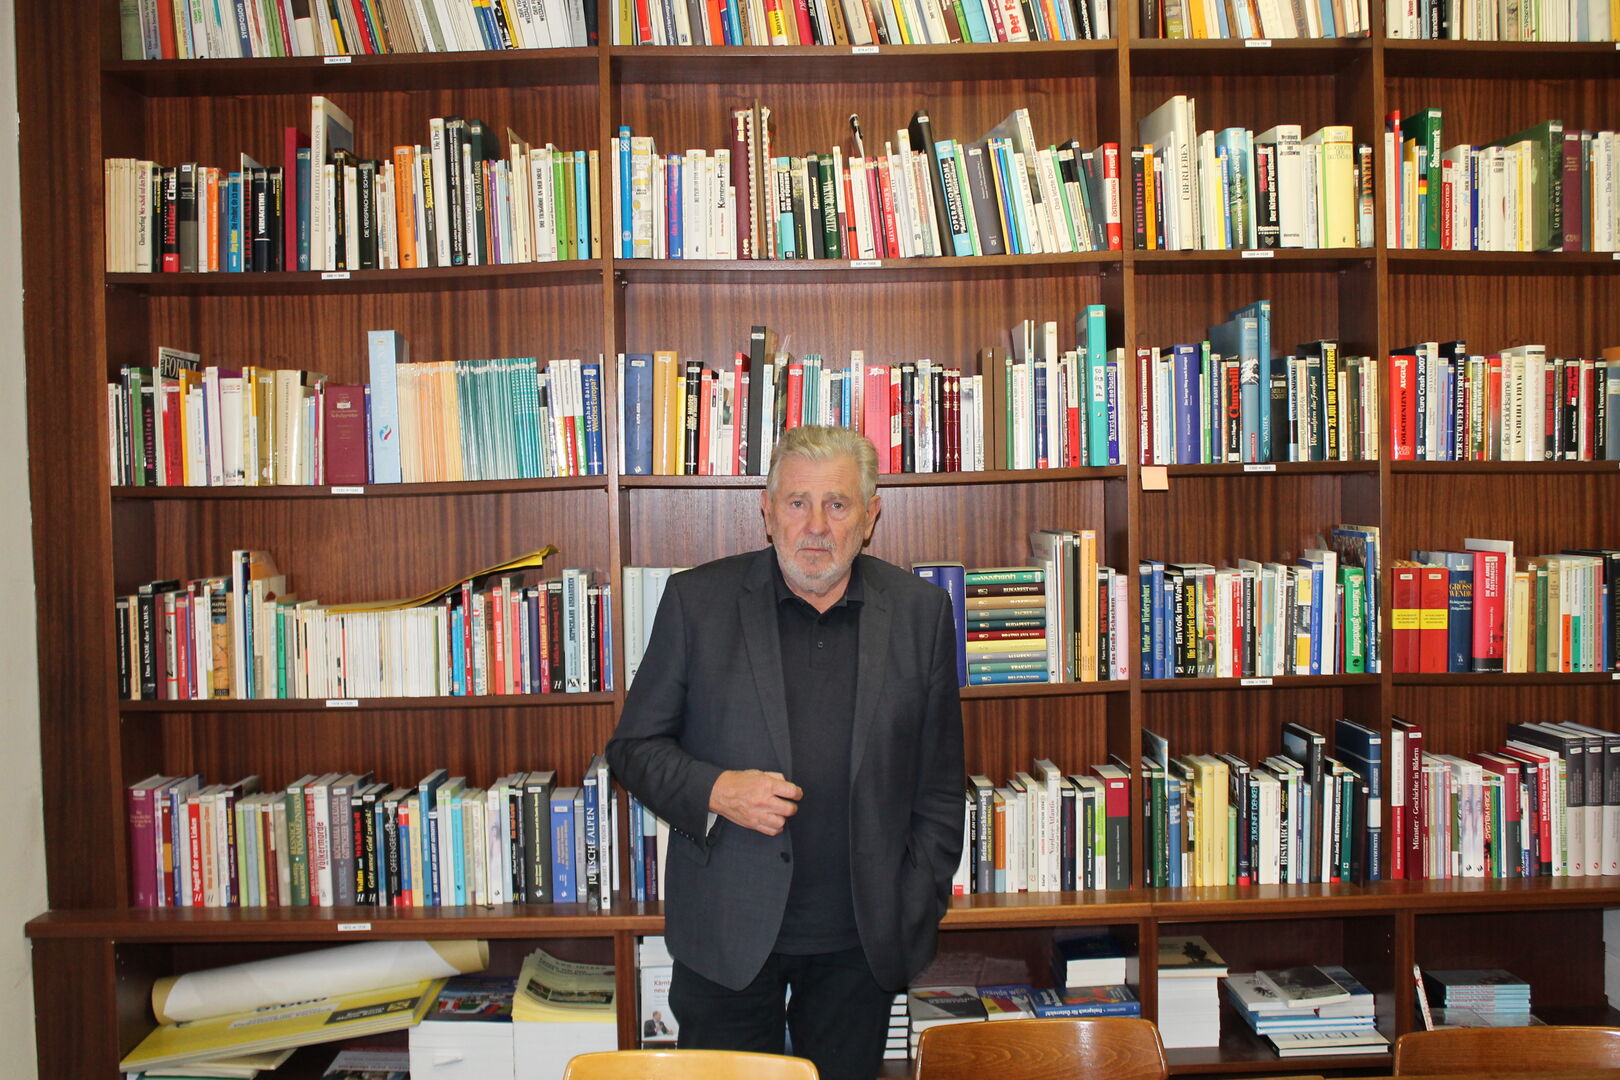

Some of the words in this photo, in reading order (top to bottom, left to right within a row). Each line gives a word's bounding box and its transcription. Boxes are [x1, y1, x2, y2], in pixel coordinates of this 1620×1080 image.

[1228, 368, 1239, 418] Churchill
[1176, 604, 1182, 614] im
[586, 808, 595, 838] ALPEN
[588, 840, 598, 884] JULISCHE
